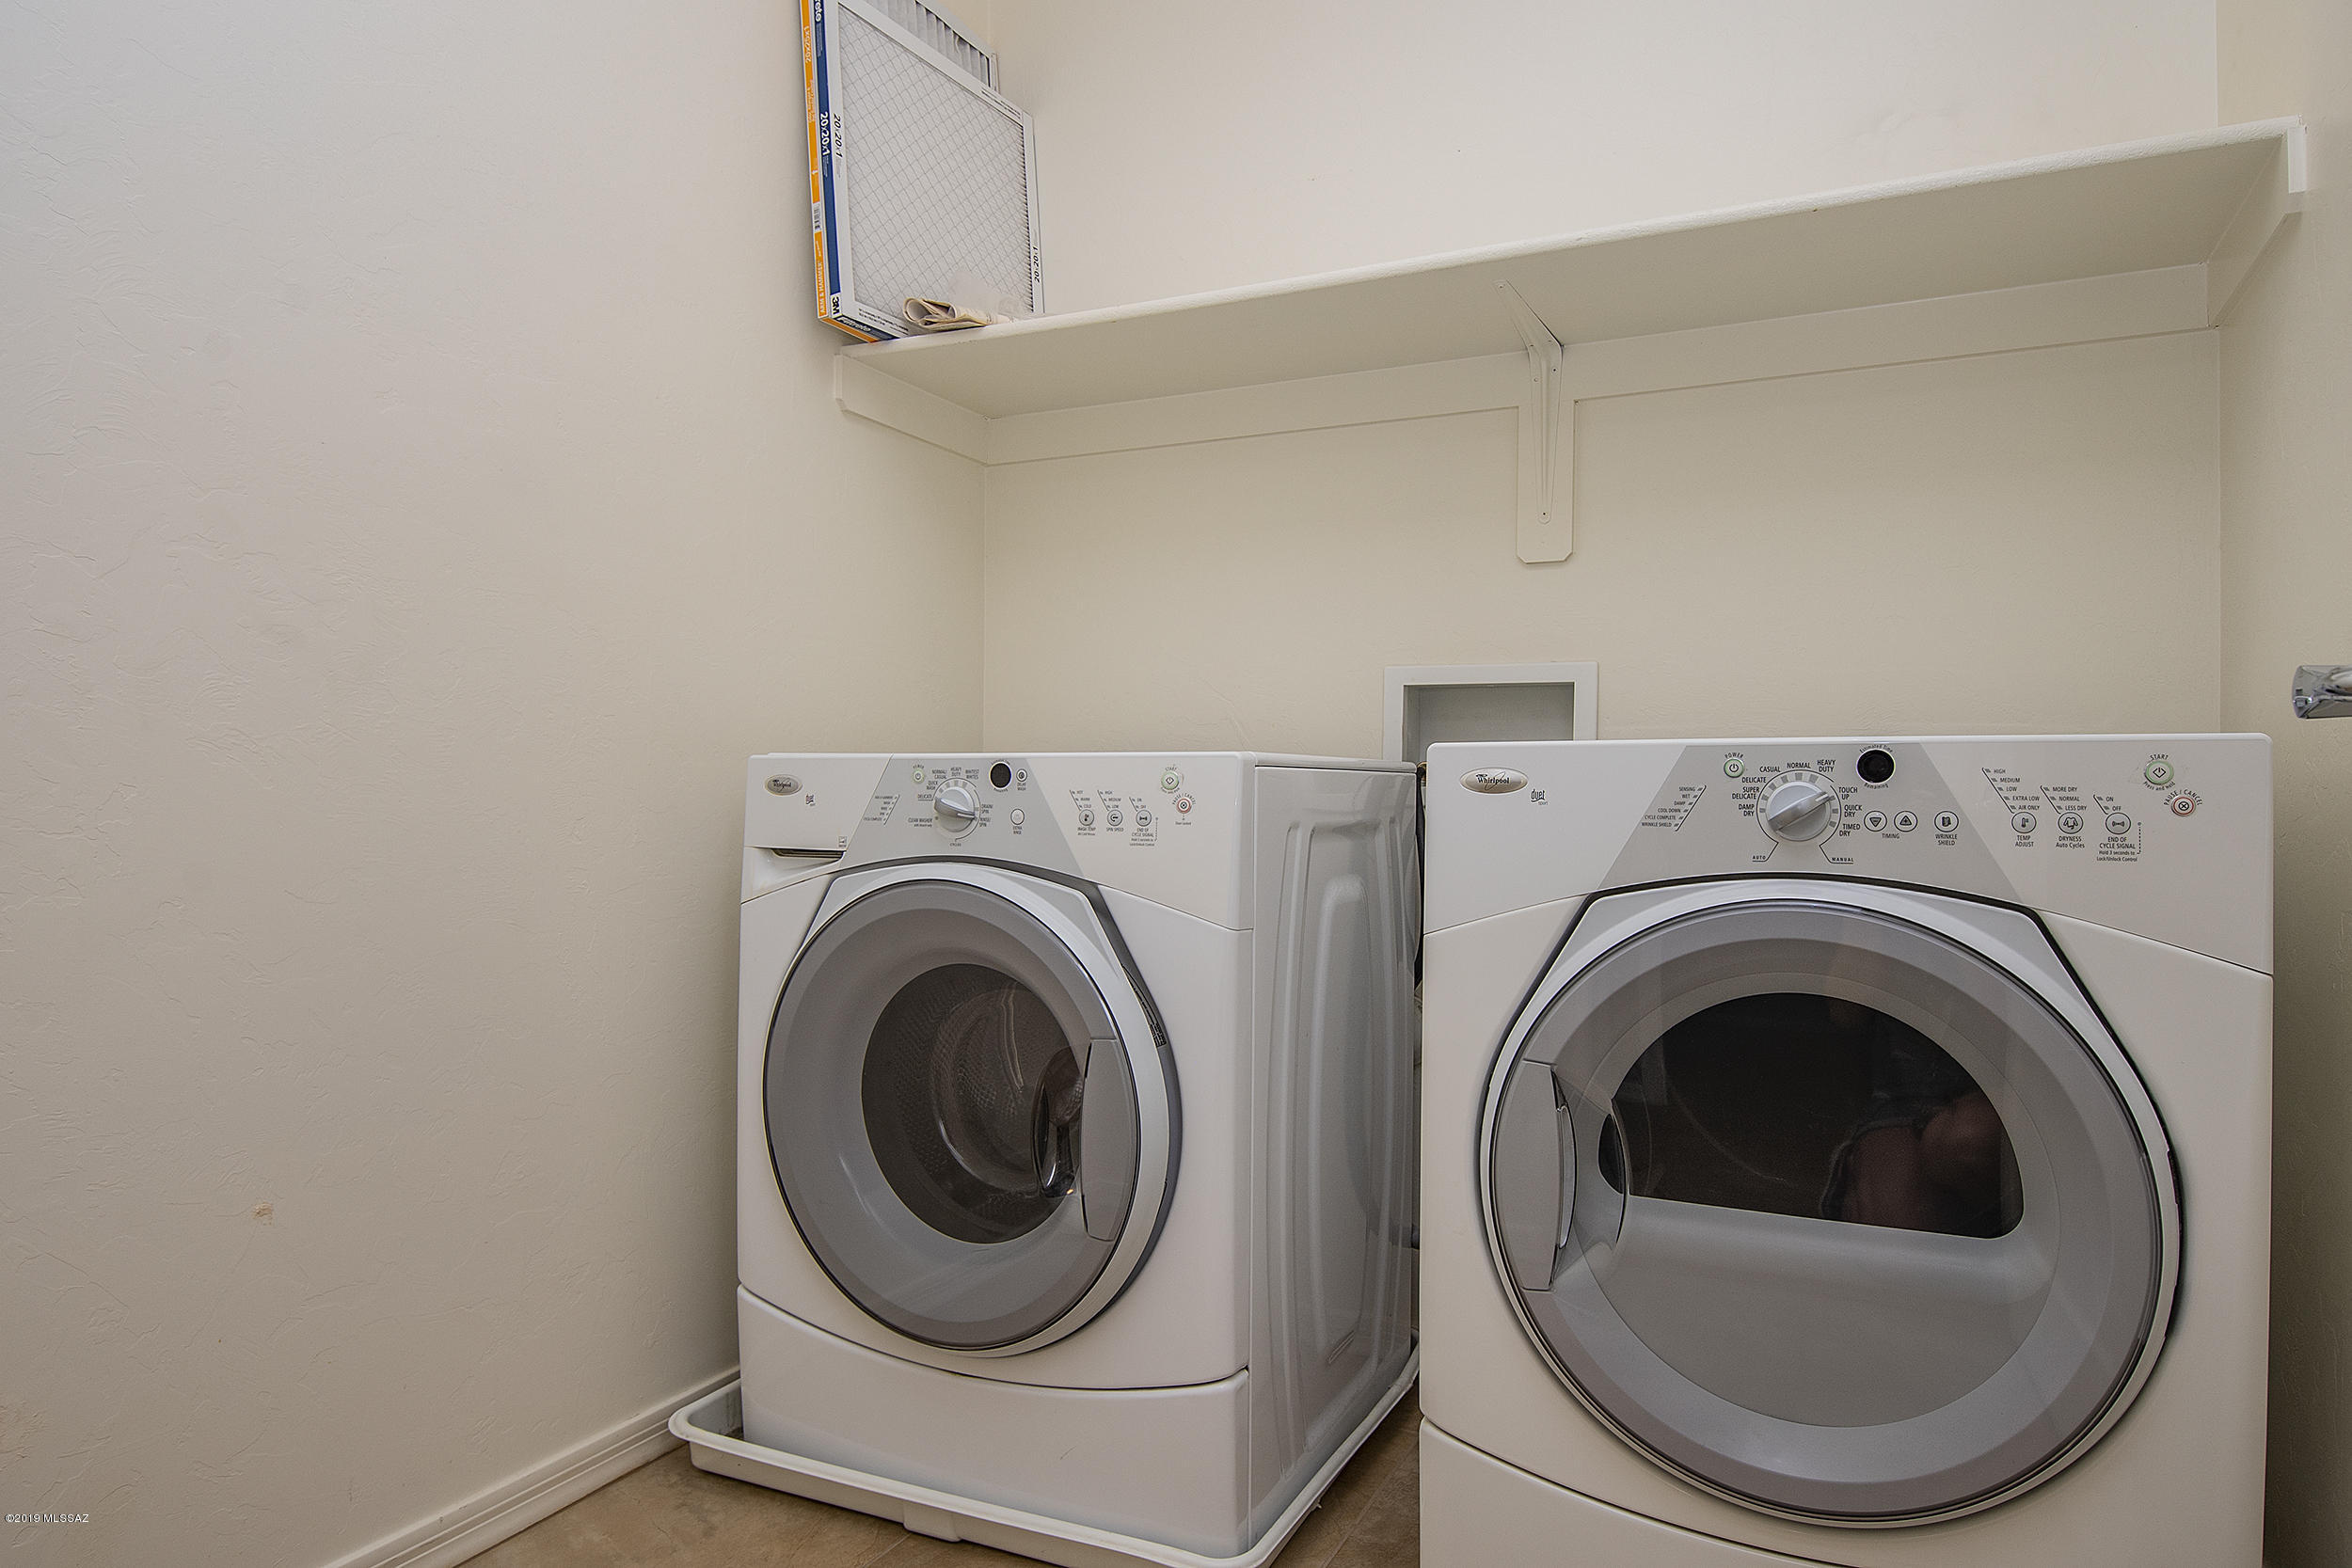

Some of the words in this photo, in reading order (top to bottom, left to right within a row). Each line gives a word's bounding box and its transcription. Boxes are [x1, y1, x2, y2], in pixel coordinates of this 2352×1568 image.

[820, 111, 831, 156] 20x20x1
[834, 113, 843, 158] 20x20x1
[832, 296, 840, 315] 3M
[1477, 777, 1510, 785] Whirlpool
[1531, 789, 1545, 801] duet
[2164, 790, 2178, 806] PAUSE
[2184, 789, 2203, 805] CANCEL
